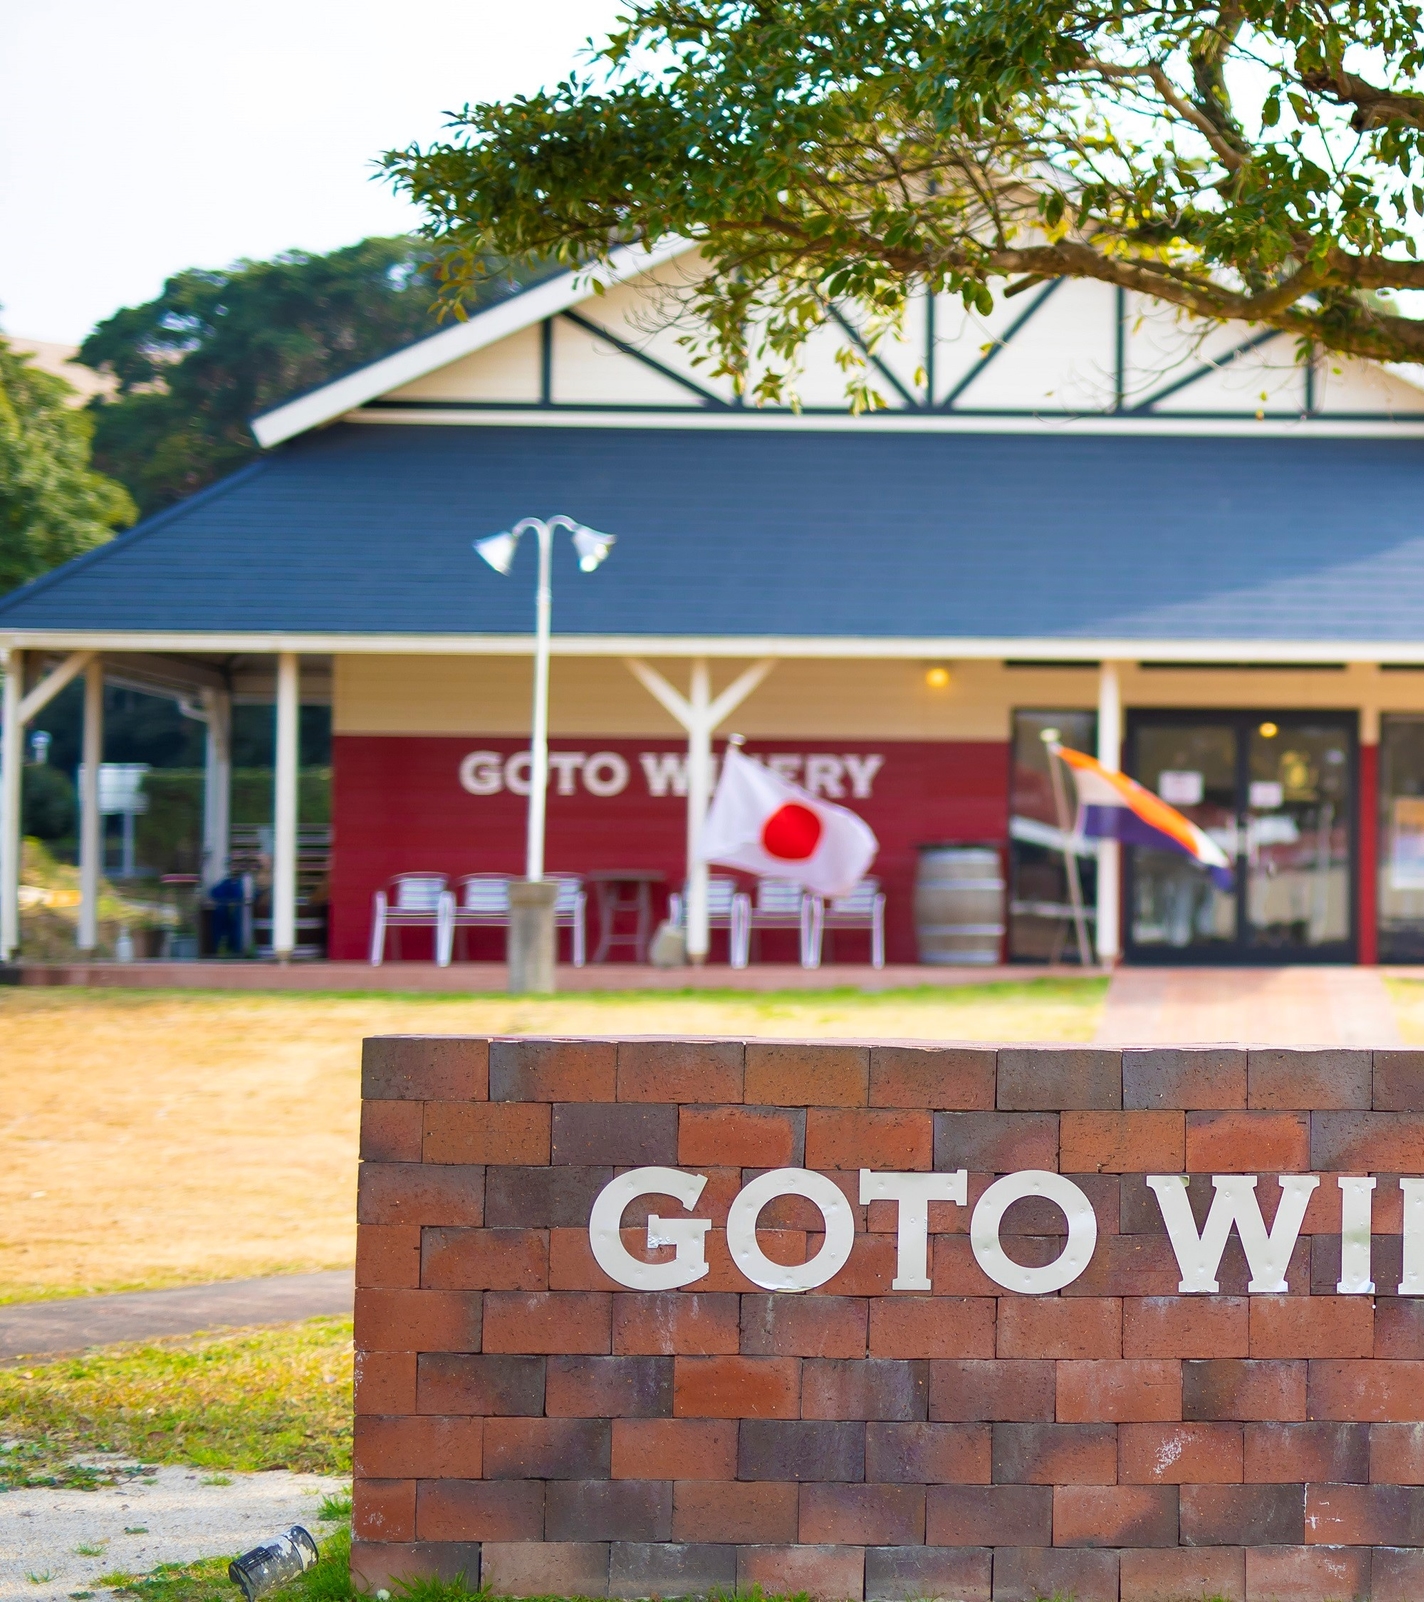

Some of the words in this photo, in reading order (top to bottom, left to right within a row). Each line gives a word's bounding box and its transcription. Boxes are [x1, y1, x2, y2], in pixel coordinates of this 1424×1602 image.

[459, 750, 631, 796] GOTO
[639, 752, 884, 799] WERY
[589, 1166, 1097, 1294] GOTO
